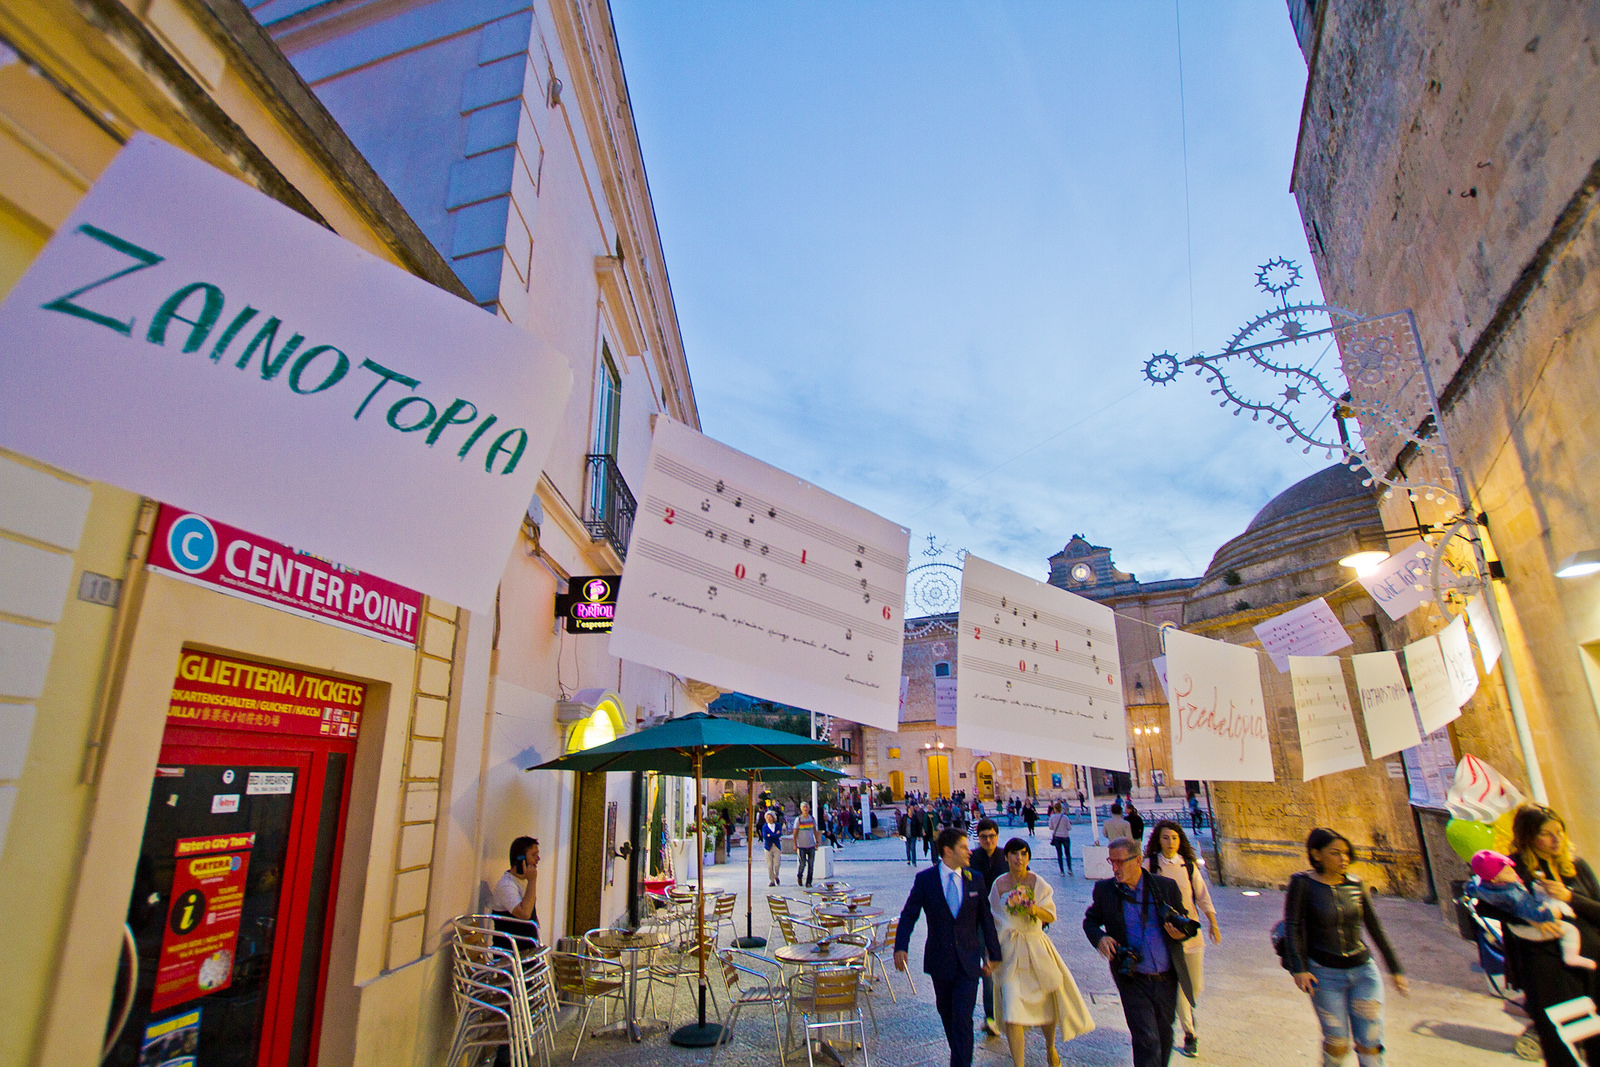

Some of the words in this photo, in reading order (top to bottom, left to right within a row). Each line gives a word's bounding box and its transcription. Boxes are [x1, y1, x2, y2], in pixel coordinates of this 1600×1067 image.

[181, 531, 204, 562] C
[663, 507, 675, 525] 2
[735, 563, 745, 580] 0
[801, 549, 807, 564] 1
[882, 606, 891, 620] 6
[225, 539, 345, 609] CENTER
[348, 583, 417, 633] POINT
[974, 627, 981, 640] 2
[1019, 660, 1026, 672] 0
[1055, 640, 1059, 652] 1
[1107, 674, 1113, 685] 6
